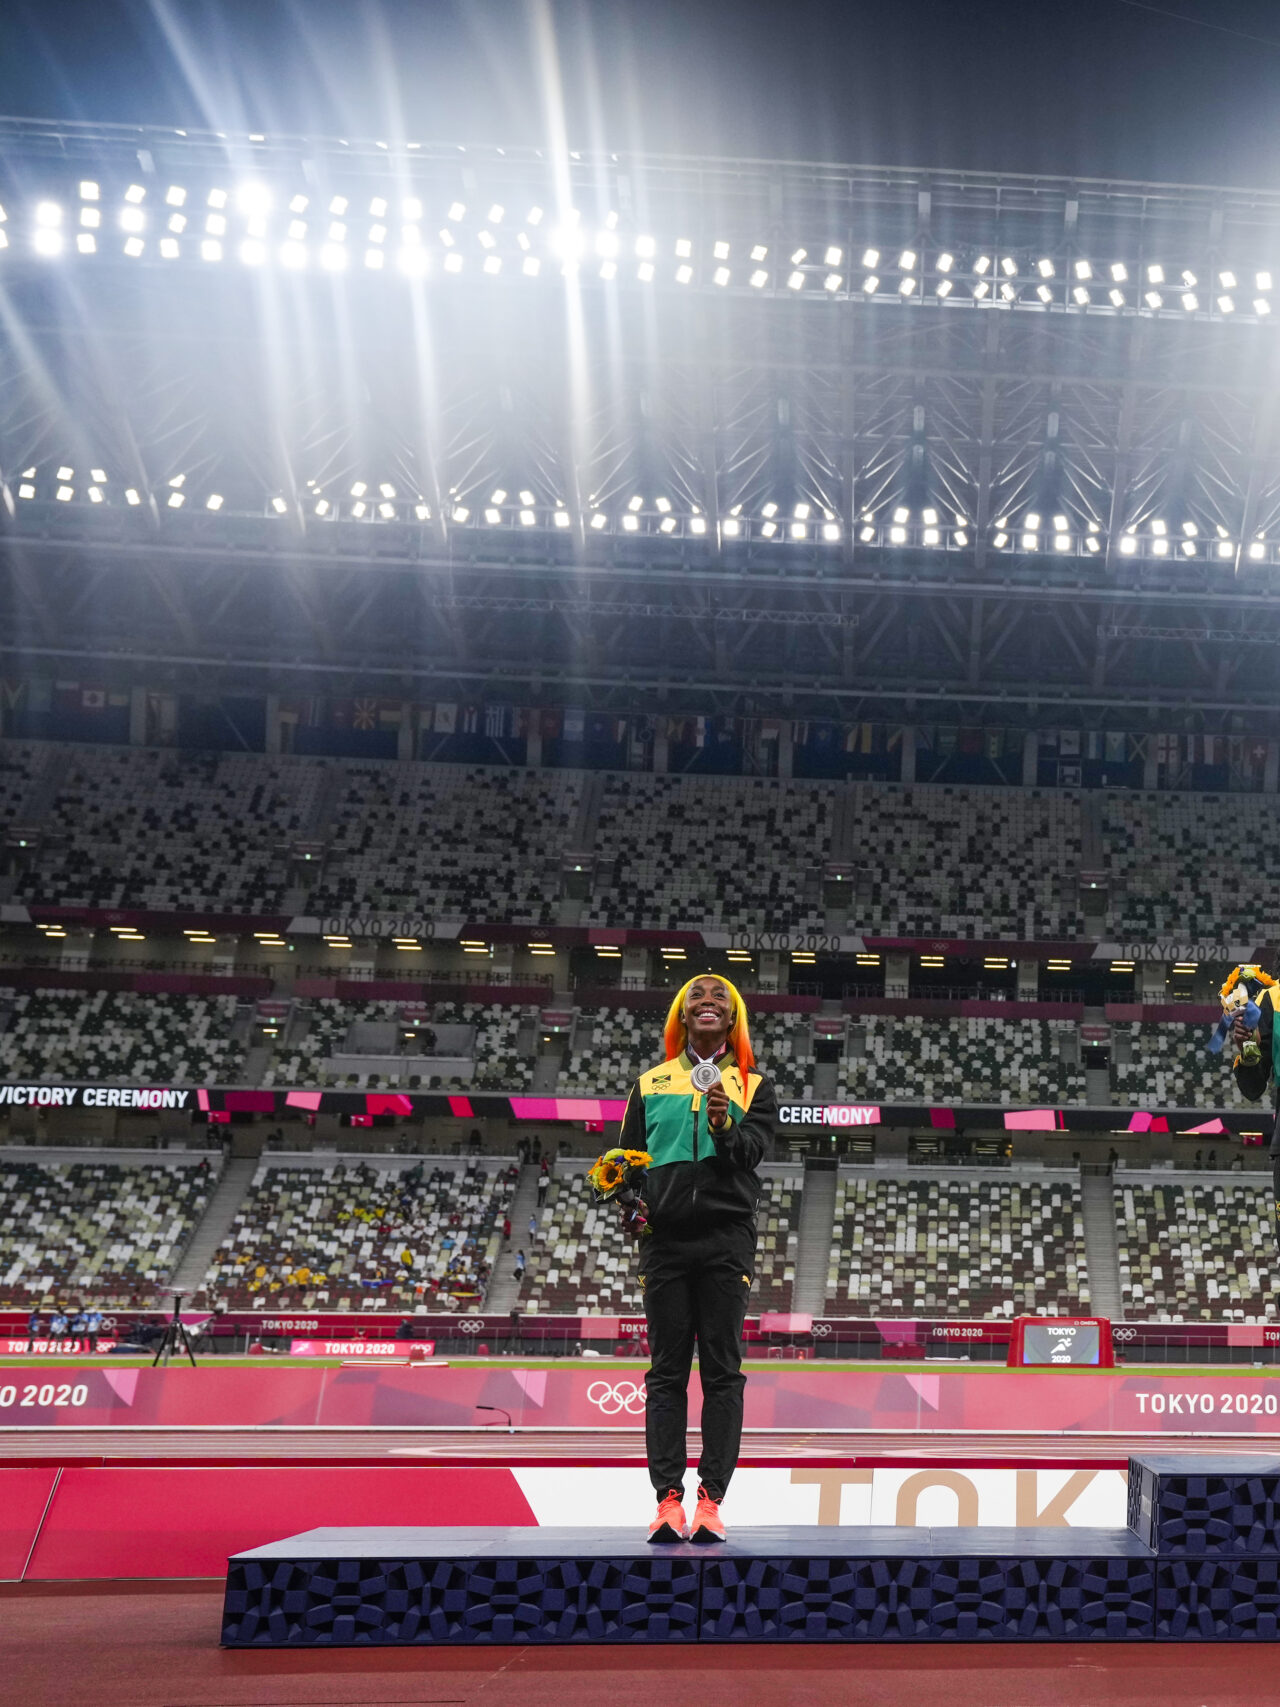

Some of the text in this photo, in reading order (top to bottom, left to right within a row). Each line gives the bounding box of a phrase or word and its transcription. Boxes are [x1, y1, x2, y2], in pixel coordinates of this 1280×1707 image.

[317, 918, 435, 938] TOKYO 2020
[728, 933, 840, 952] TOKYO 2020
[1121, 943, 1229, 961] TOKYO 2020
[82, 1088, 188, 1109] CEREMONY
[779, 1106, 873, 1125] CEREMONY
[262, 1320, 318, 1330] TOKYO 2020
[932, 1327, 983, 1337] TOKYO 2020
[1047, 1327, 1077, 1336] TOKYO
[325, 1343, 395, 1354] TOKYO 2020
[1051, 1355, 1072, 1363] 2020
[20, 1384, 88, 1406] 2020
[1136, 1393, 1278, 1415] TOKYO 2020
[790, 1468, 1128, 1528] TOK
